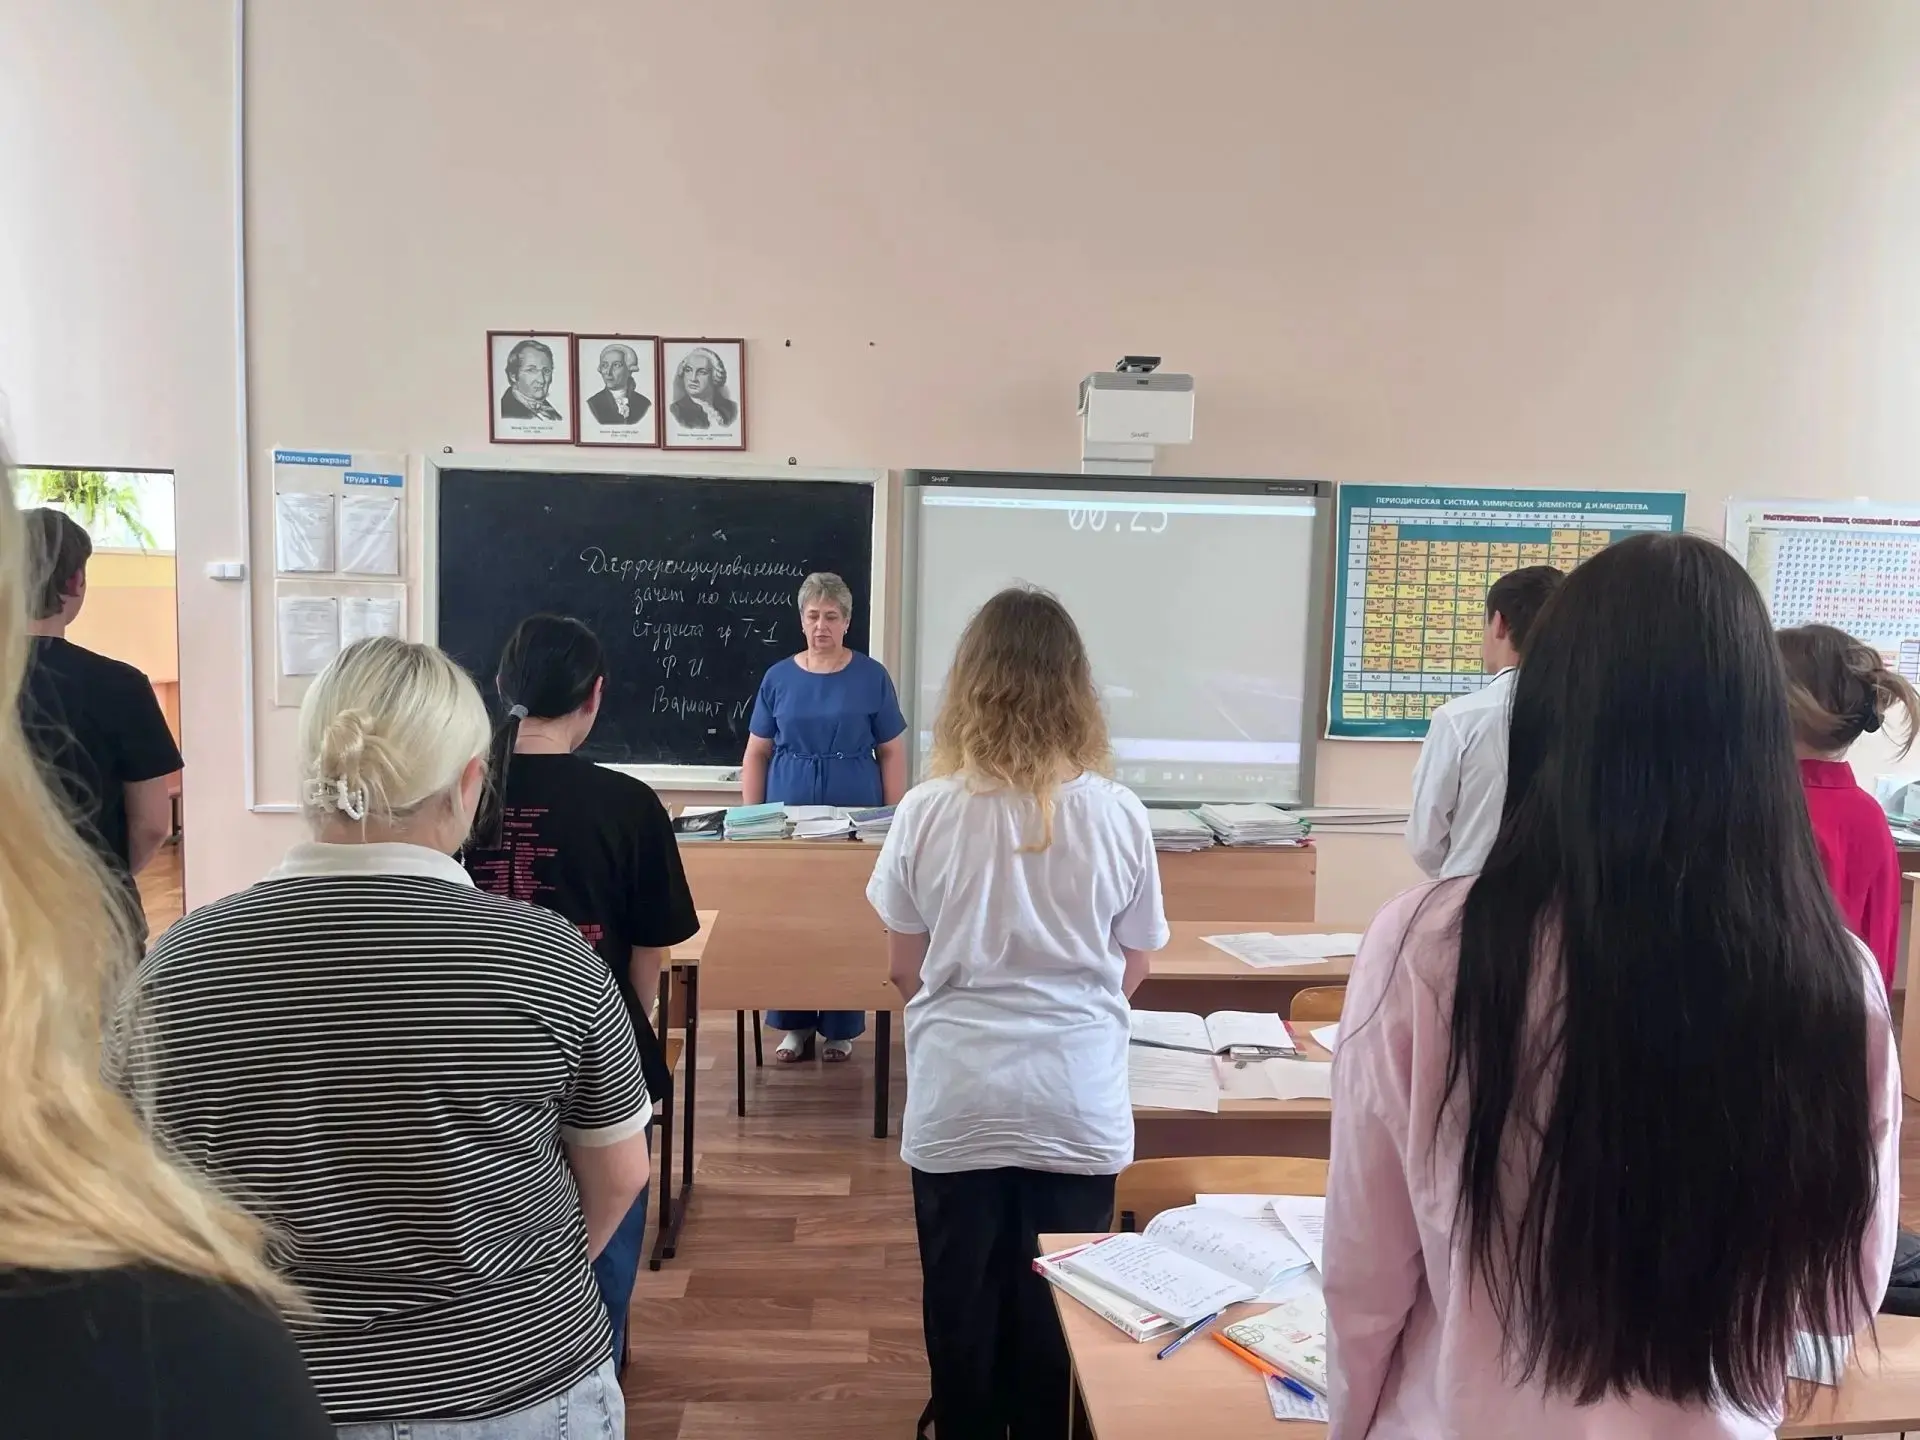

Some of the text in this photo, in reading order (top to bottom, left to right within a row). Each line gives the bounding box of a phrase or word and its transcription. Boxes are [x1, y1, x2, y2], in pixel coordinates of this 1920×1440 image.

[276, 454, 306, 462] Уголок
[346, 476, 369, 484] труда
[1376, 497, 1440, 506] ПЕРИОДИЧЕСКАЯ
[1536, 501, 1582, 509] ЭЛЕМЕНТОВ
[635, 587, 792, 615] зачет по химии
[652, 685, 724, 720] Вариант
